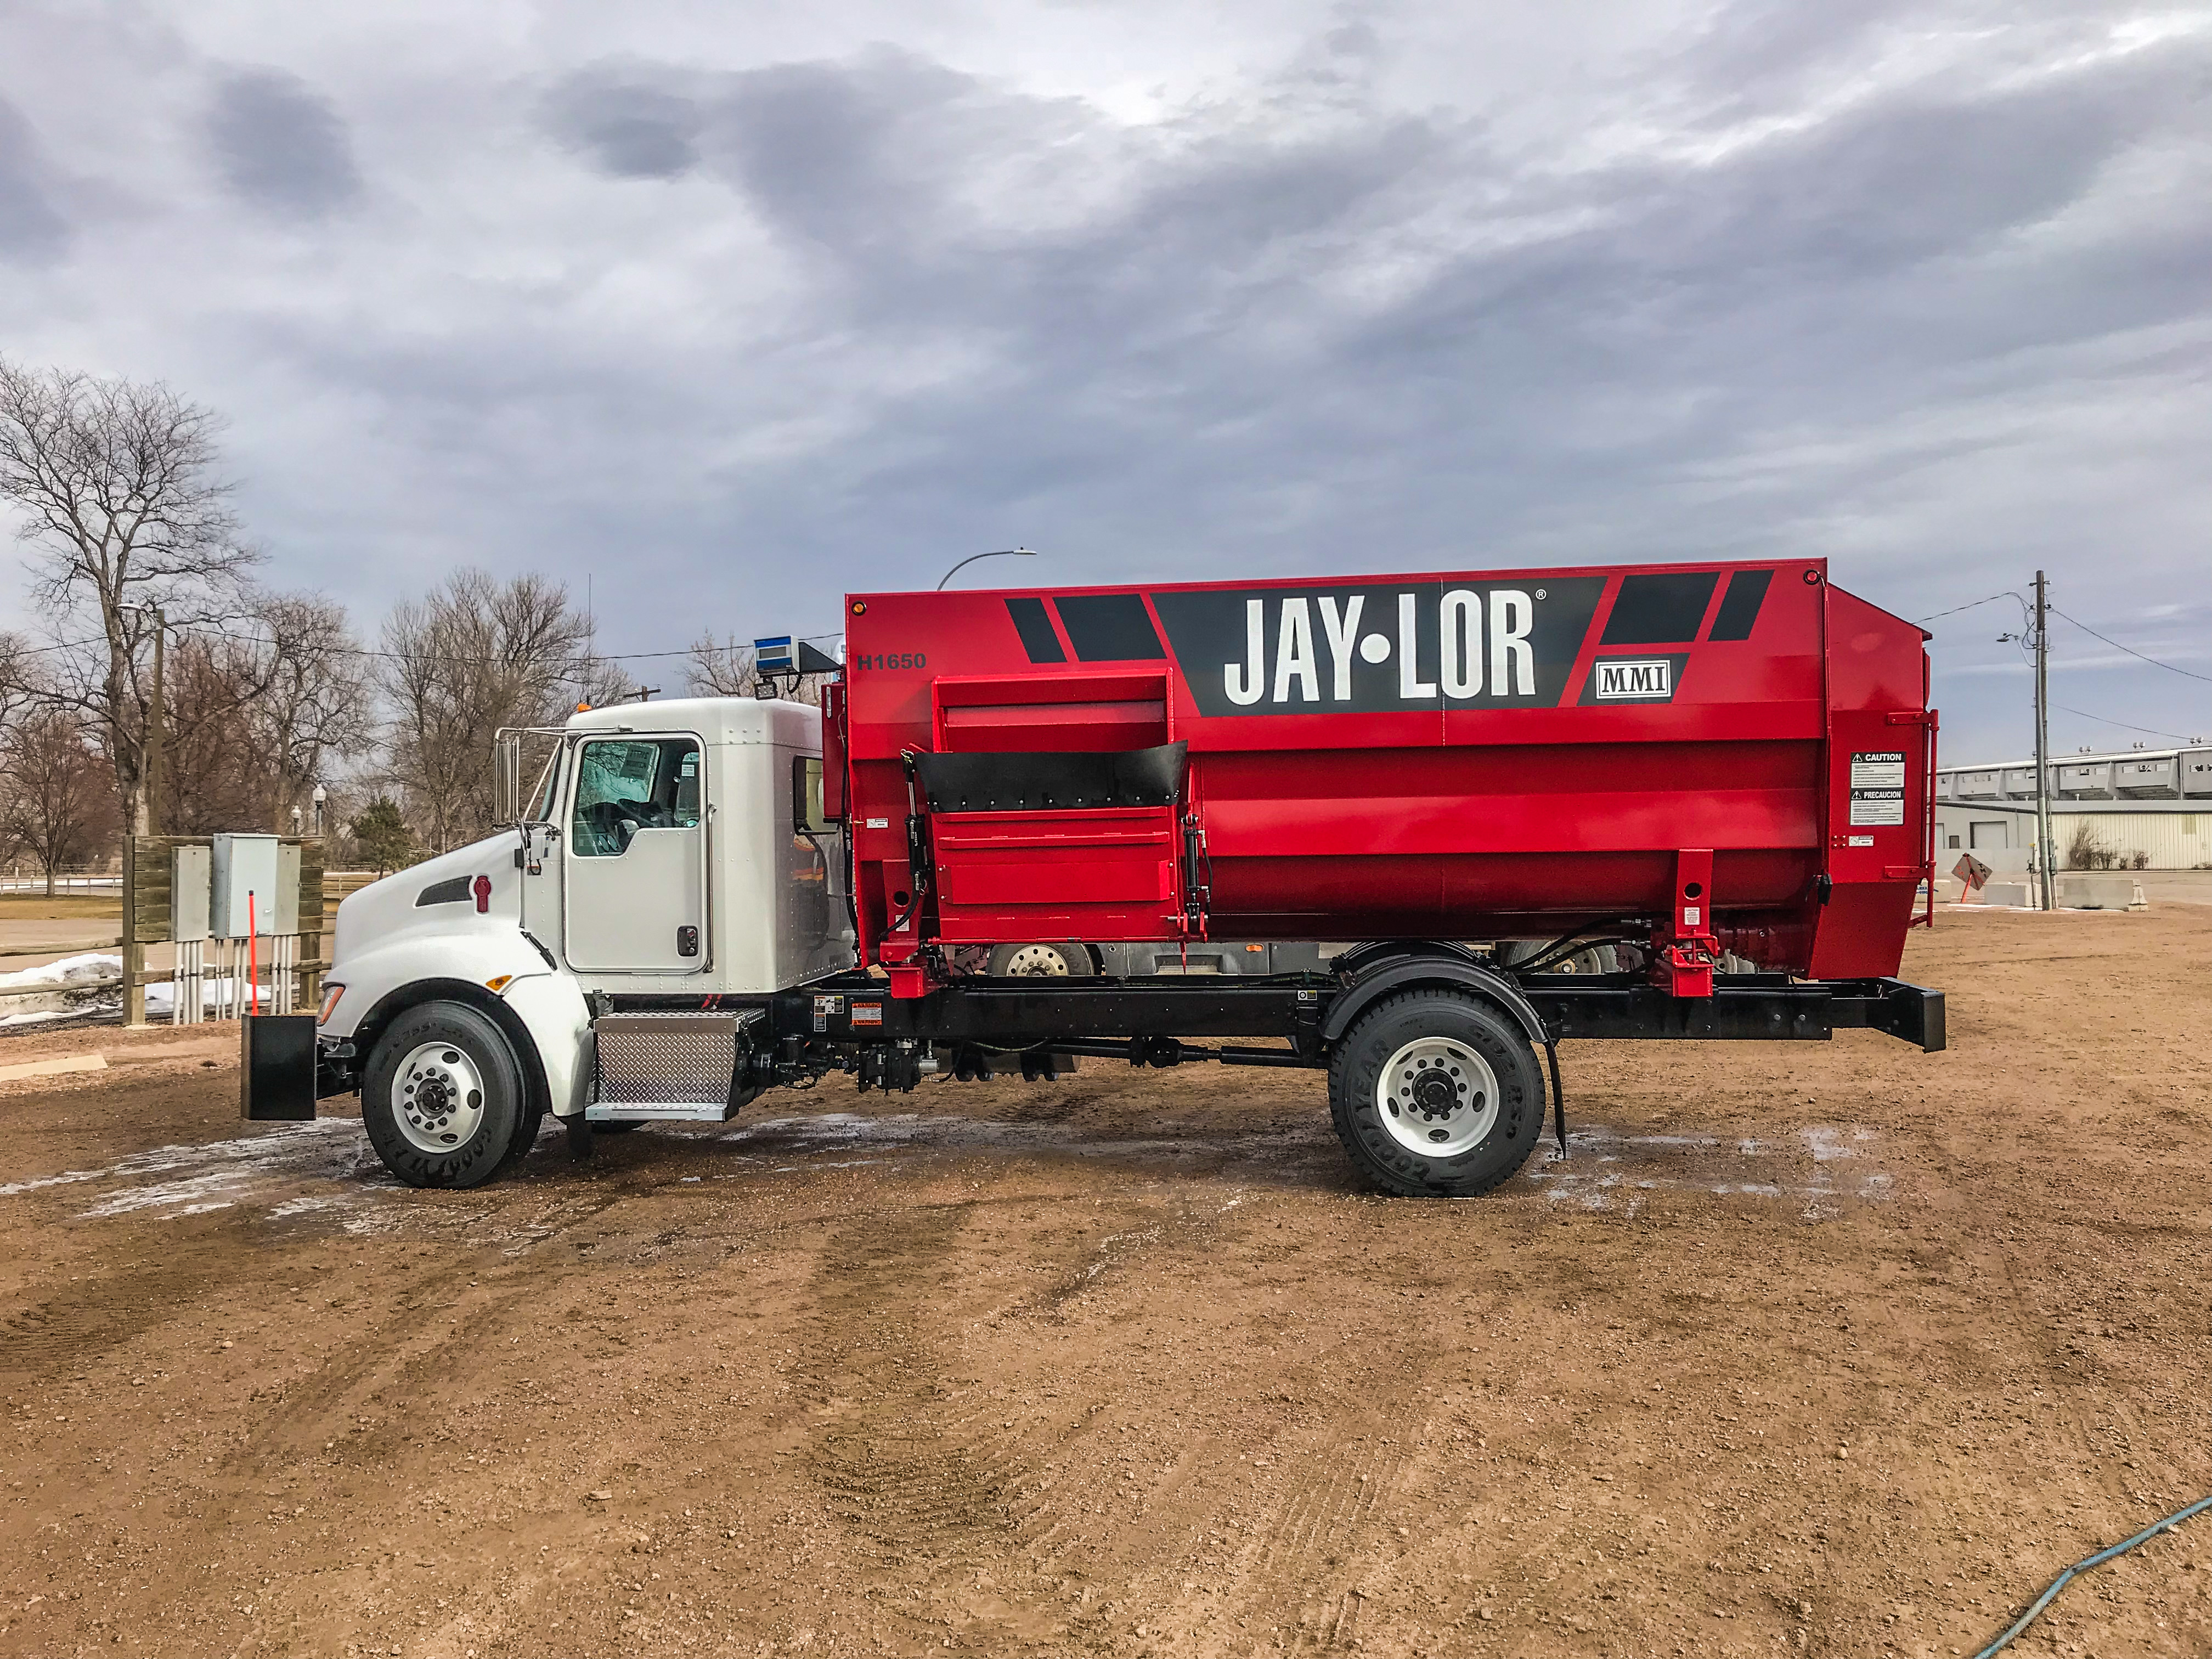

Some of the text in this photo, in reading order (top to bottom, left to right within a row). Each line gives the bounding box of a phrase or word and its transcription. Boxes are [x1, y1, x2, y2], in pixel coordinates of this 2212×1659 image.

[857, 653, 926, 670] H1650
[1601, 666, 1666, 693] MMI
[1865, 753, 1901, 761] CAUTION
[1864, 791, 1901, 799] PRECAUCION
